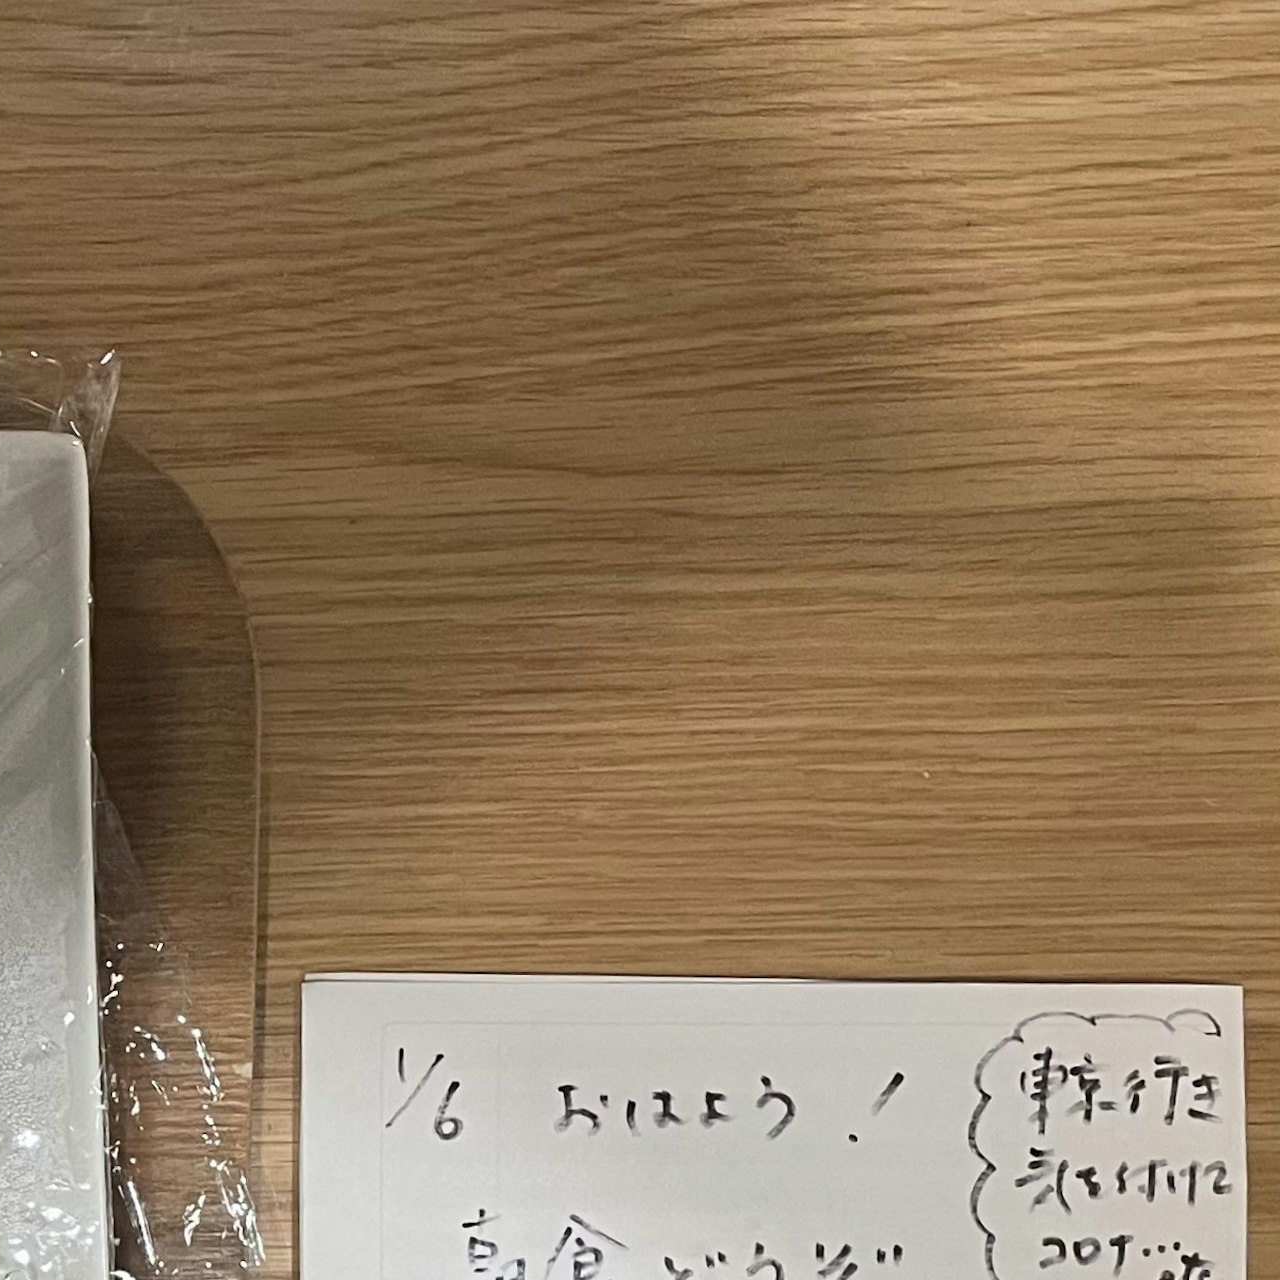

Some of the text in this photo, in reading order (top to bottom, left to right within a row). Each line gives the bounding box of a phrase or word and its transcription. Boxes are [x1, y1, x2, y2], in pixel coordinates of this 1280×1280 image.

[383, 1045, 465, 1143] 1/6
[1016, 1045, 1223, 1136] 東京行き
